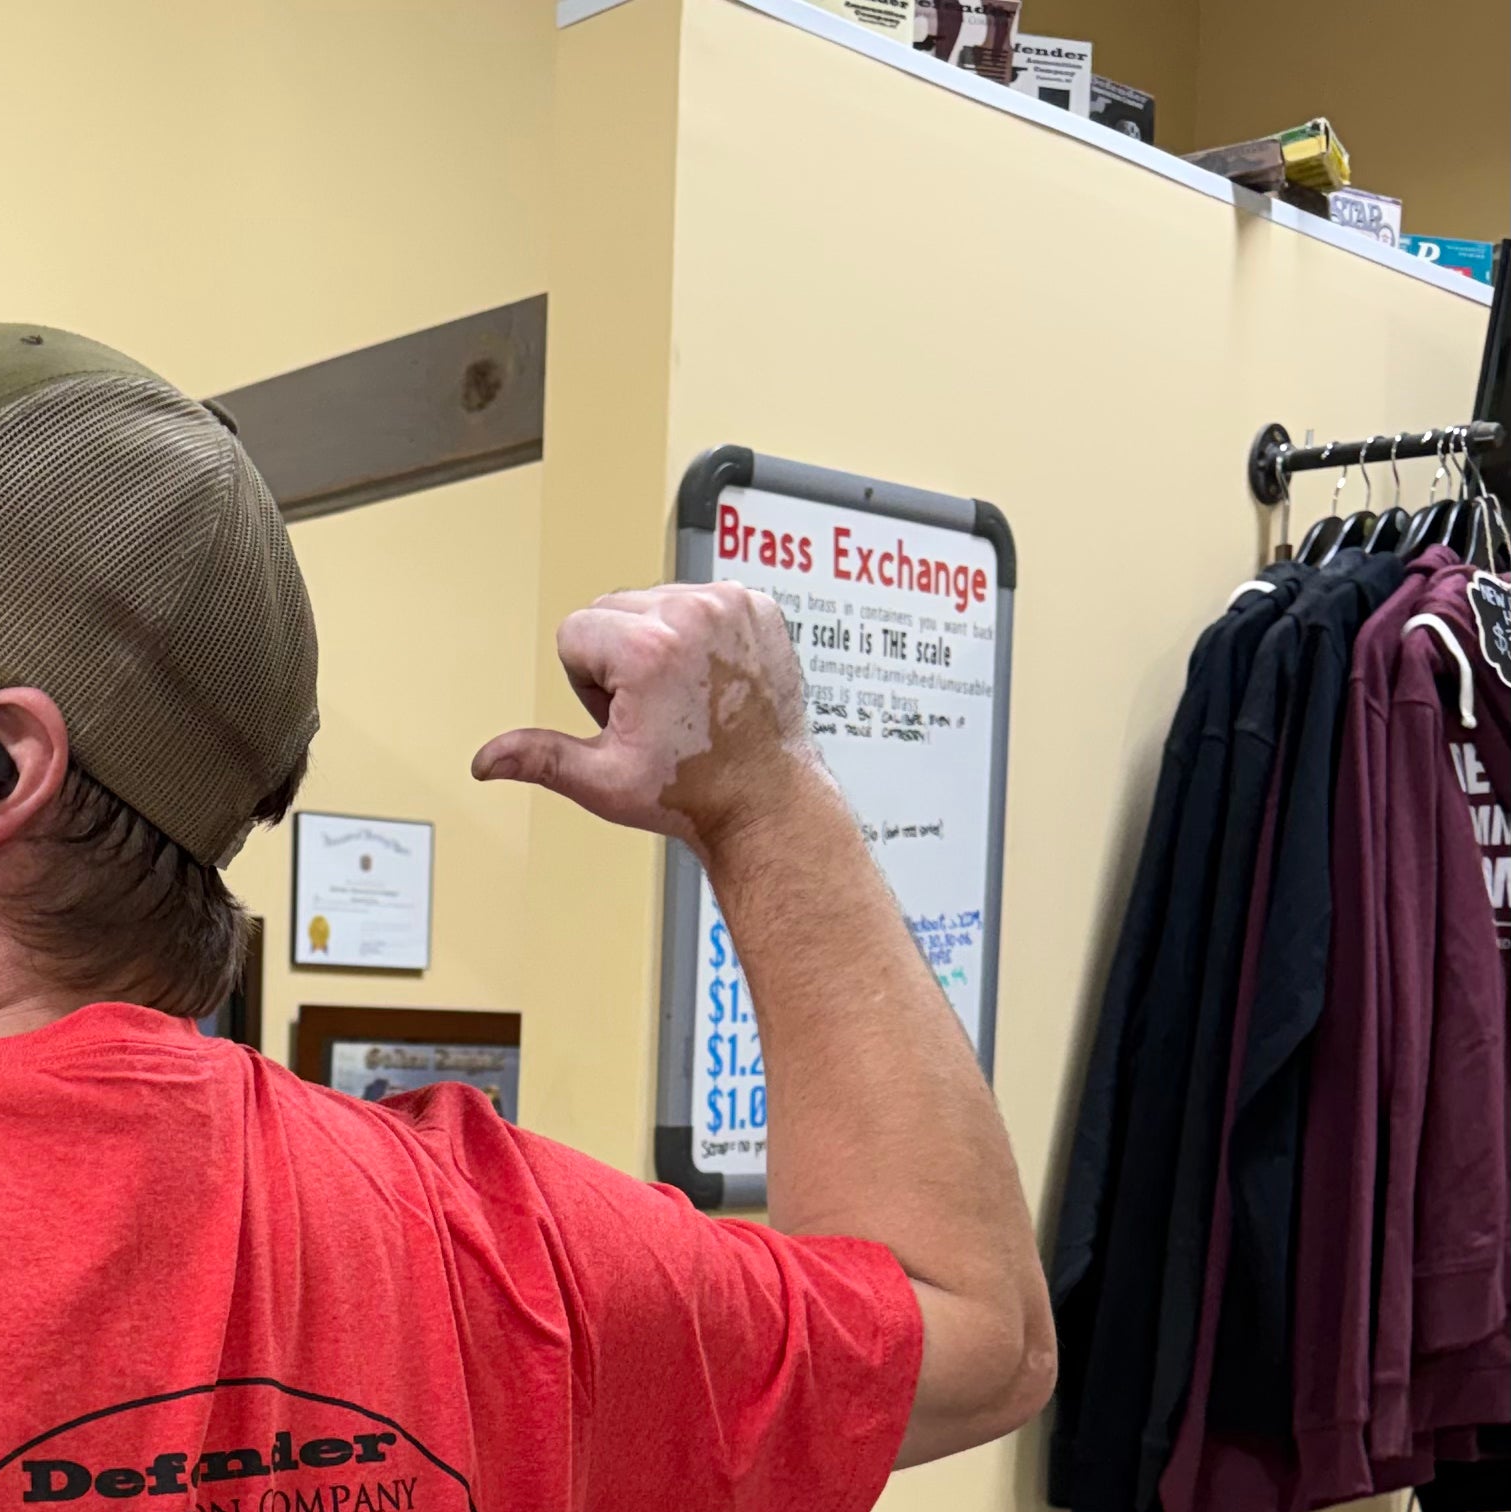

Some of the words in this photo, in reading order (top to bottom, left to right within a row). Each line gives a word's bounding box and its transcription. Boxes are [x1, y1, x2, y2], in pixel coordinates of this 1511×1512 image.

[1013, 42, 1088, 61] fender
[718, 503, 813, 574] Brass
[833, 526, 988, 613] Exchange
[807, 592, 837, 615] brass
[843, 602, 854, 616] in
[859, 604, 914, 628] containers
[919, 615, 937, 633] you
[943, 622, 968, 637] want
[811, 618, 851, 652] scale
[859, 623, 873, 655] is
[881, 628, 908, 661] THE
[915, 636, 952, 668] scale
[890, 690, 920, 713] brass
[706, 1029, 767, 1081] $1.2
[706, 1081, 768, 1136] $1.0
[23, 1431, 397, 1503] Defnder
